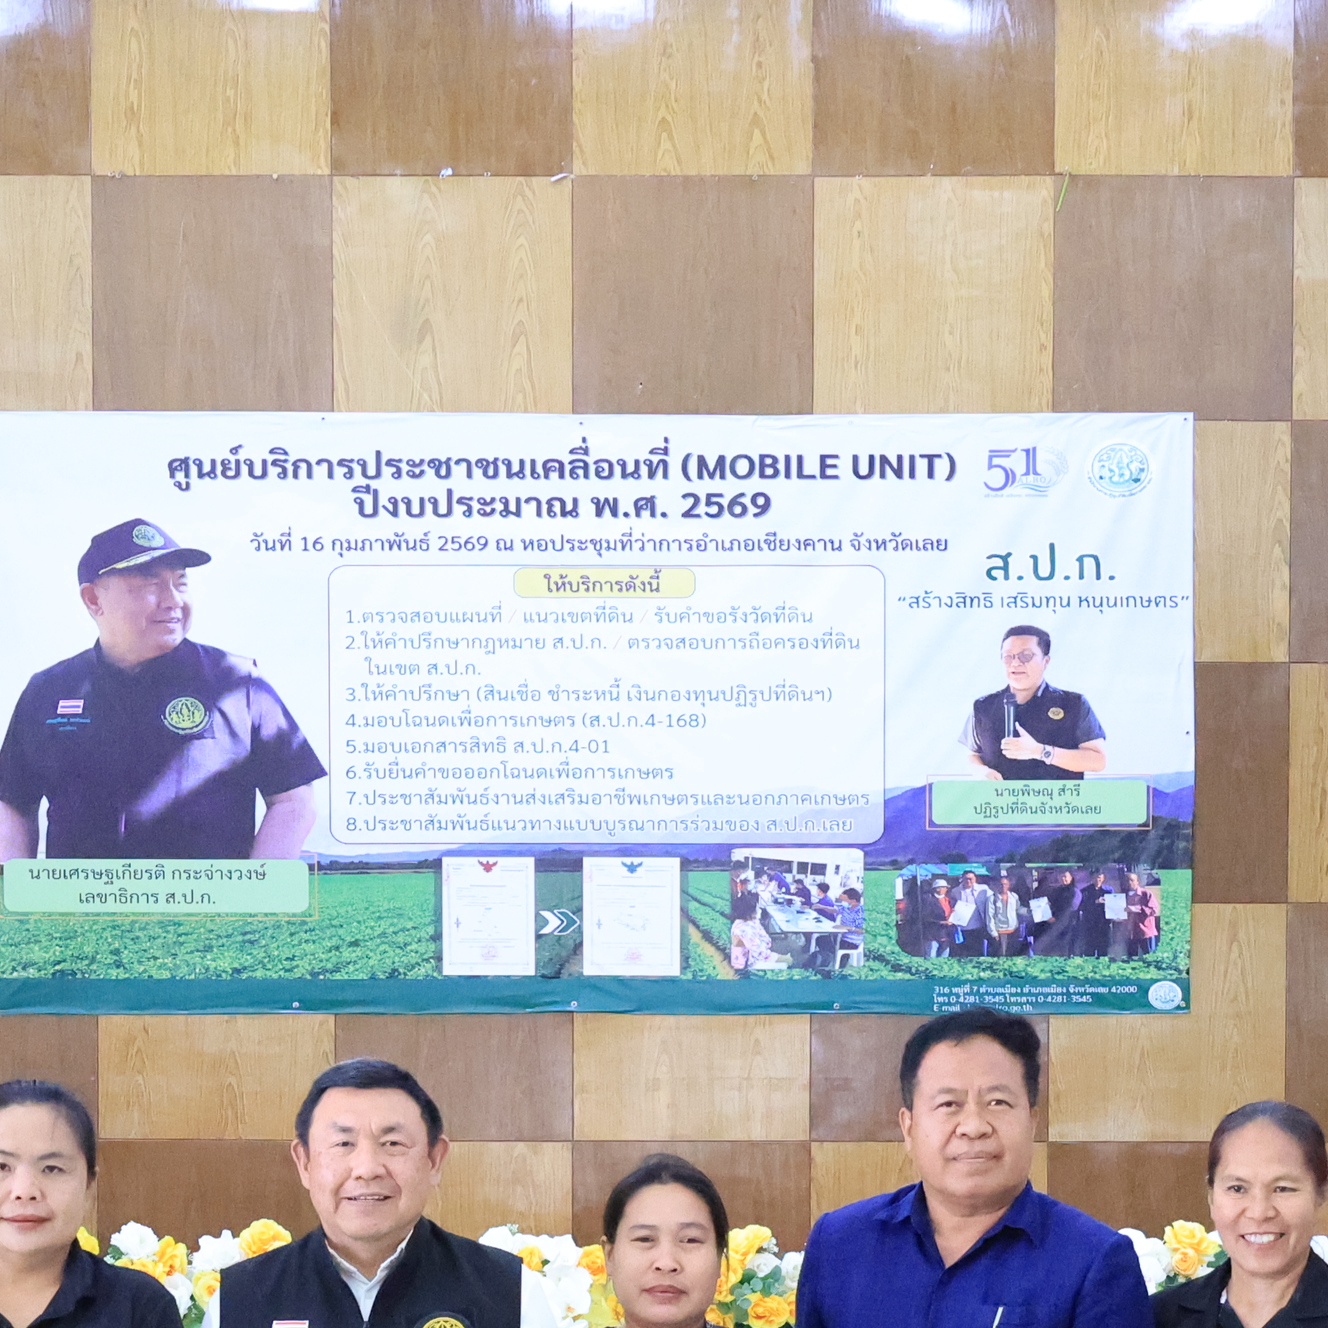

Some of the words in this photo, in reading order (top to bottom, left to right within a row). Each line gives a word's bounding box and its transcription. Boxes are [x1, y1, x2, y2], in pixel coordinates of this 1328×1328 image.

[168, 437, 669, 491] ศูนย์บริการประชาชนเคลื่อนที่
[680, 453, 840, 481] (MOBILE
[852, 453, 957, 481] UNIT)
[351, 484, 579, 518] ปีงบประมาณ
[591, 494, 668, 518] พ.ศ.
[680, 491, 772, 519] 2569
[250, 527, 293, 552] วันที่
[301, 535, 325, 552] 16
[331, 531, 431, 558] กุมภาพันธ์
[437, 535, 489, 552] 2569
[495, 538, 514, 552] ณ
[520, 527, 843, 558] หอประชุมที่ว่าการอำเภอเชียงคาน
[850, 531, 949, 553] จังหวัดเลย
[985, 542, 1116, 581] ส.ป.ก.
[543, 568, 661, 594] ให้บริการดังนี้
[346, 600, 502, 624] 1.ตรวจสอบแผนที่
[523, 600, 634, 624] แนวเขตที่ดิน
[654, 600, 814, 624] รับคำขอรังวัดที่ดิน
[345, 630, 546, 655] 2.ให้คำปรึกษากฎหมาย
[552, 633, 607, 650] ส.ป.ก.
[627, 627, 861, 651] ตรวจสอบการถือครองที่ดิน
[364, 656, 421, 676] ในเขต
[427, 659, 481, 676] ส.ป.ก.
[345, 682, 470, 702] 3.ให้คำปรึกษา
[476, 679, 541, 702] (สินเชื่อ
[548, 677, 621, 702] ชำระหนี้
[627, 679, 833, 708] เงินกองทุนปฏิรูปที่ดินฯ)
[345, 705, 576, 728] 4.มอบโฉนดเพื่อการเกษตร
[582, 712, 707, 729] (ส.ป.ก.4-168)
[346, 736, 508, 754] 5.มอบเอกสารสิทธิ
[514, 737, 610, 754] ส.ป.ก.4-01
[346, 756, 674, 780] 6.รับยื่นคำขอออกโฉนดเพื่อการเกษตร
[994, 784, 1053, 800] นายพิษณุ
[974, 799, 1102, 818] ปฏิรูปที่ดินจังหวัดเลย
[766, 816, 853, 833] ส.ป.ก.เลย
[28, 863, 166, 885] นายเศรษฐเกียรติ
[171, 862, 267, 881] กระจ่างวงษ์
[78, 887, 159, 905] เลขาธิการ
[165, 889, 216, 905] ส.ป.ก.
[933, 986, 950, 994] 316
[1111, 985, 1138, 994] 42000
